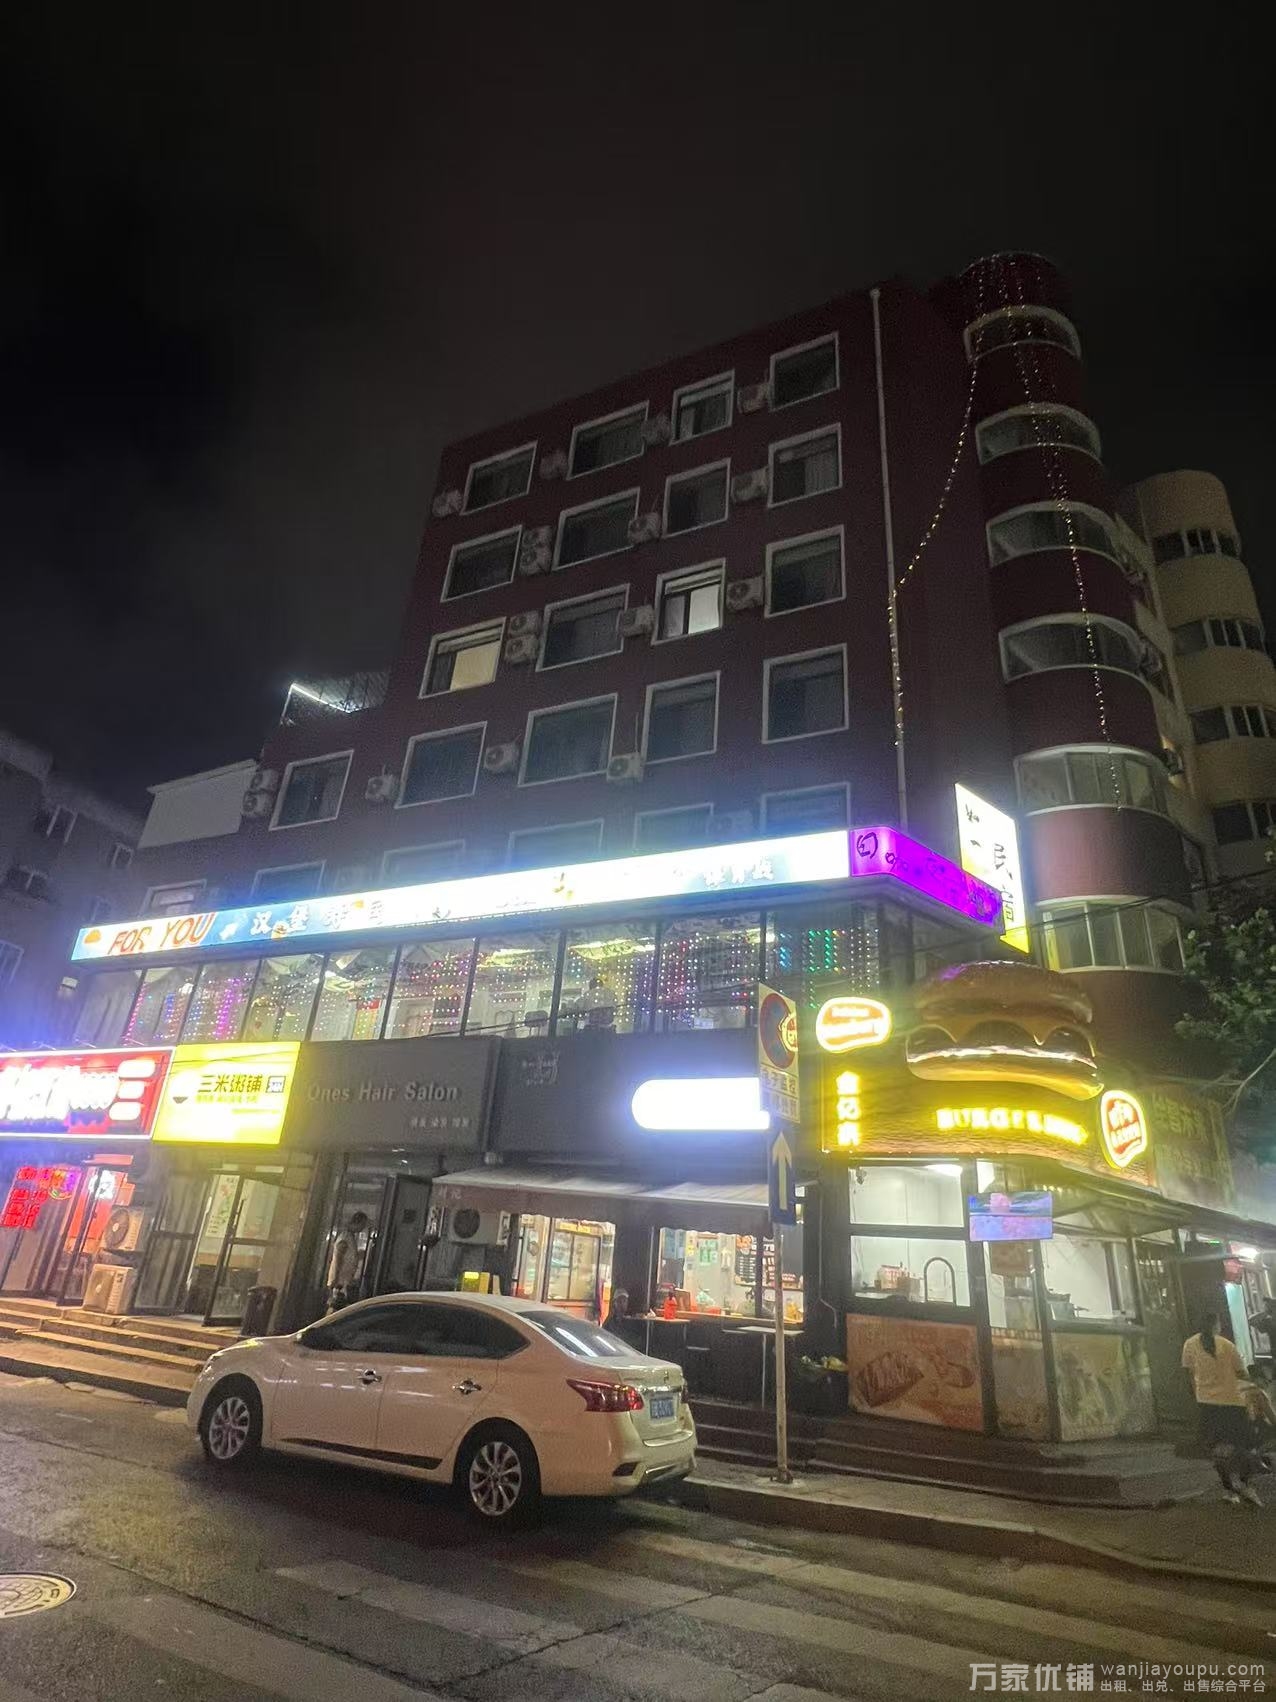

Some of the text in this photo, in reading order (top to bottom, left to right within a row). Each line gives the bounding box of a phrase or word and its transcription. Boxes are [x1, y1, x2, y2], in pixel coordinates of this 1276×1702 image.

[107, 911, 216, 955] FOR YOU
[197, 1074, 263, 1093] 三米粥铺
[358, 1080, 396, 1101] Hair
[404, 1081, 458, 1102] Salon
